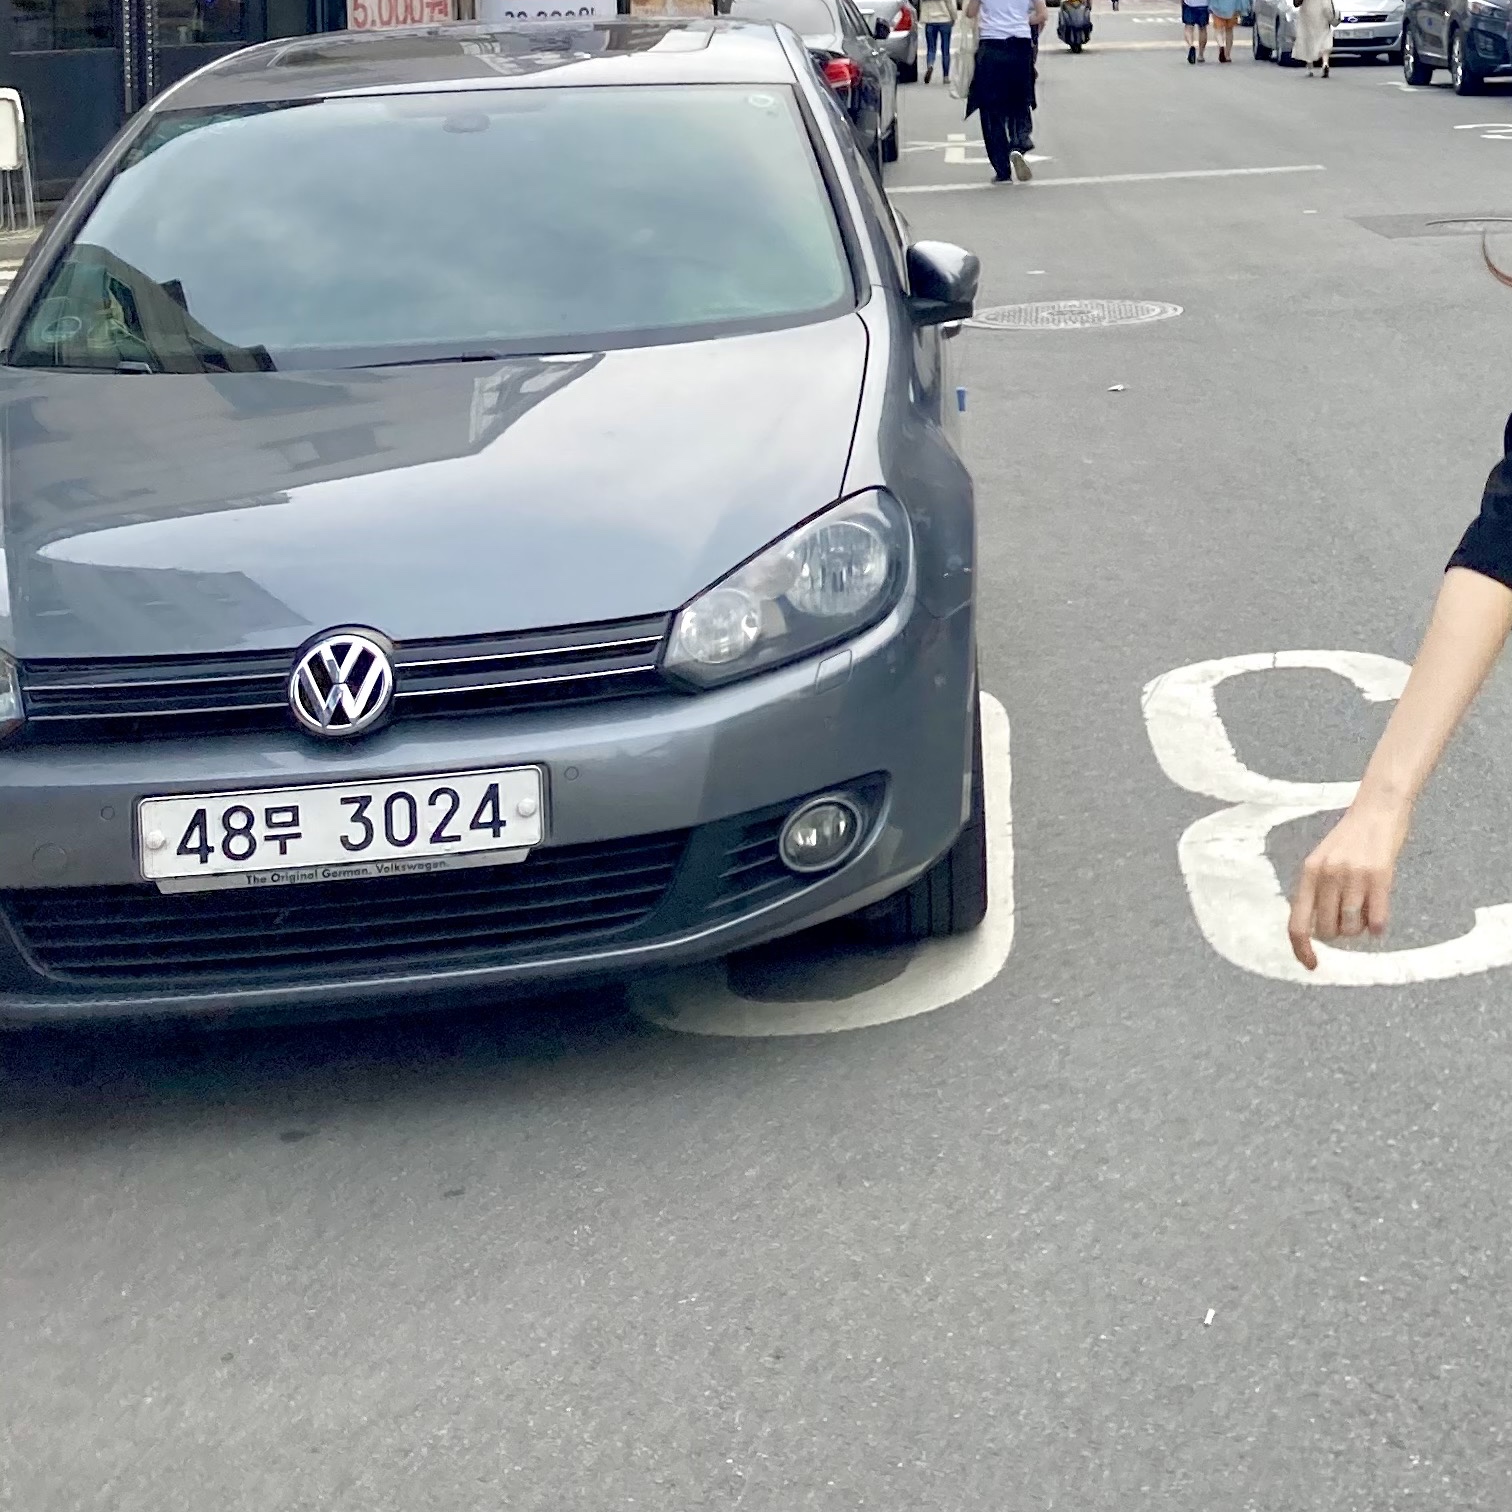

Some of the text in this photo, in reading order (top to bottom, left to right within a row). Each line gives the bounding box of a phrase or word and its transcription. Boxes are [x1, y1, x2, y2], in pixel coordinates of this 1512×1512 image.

[175, 782, 508, 865] 48무 3024
[246, 872, 267, 886] The
[270, 868, 319, 885] Original
